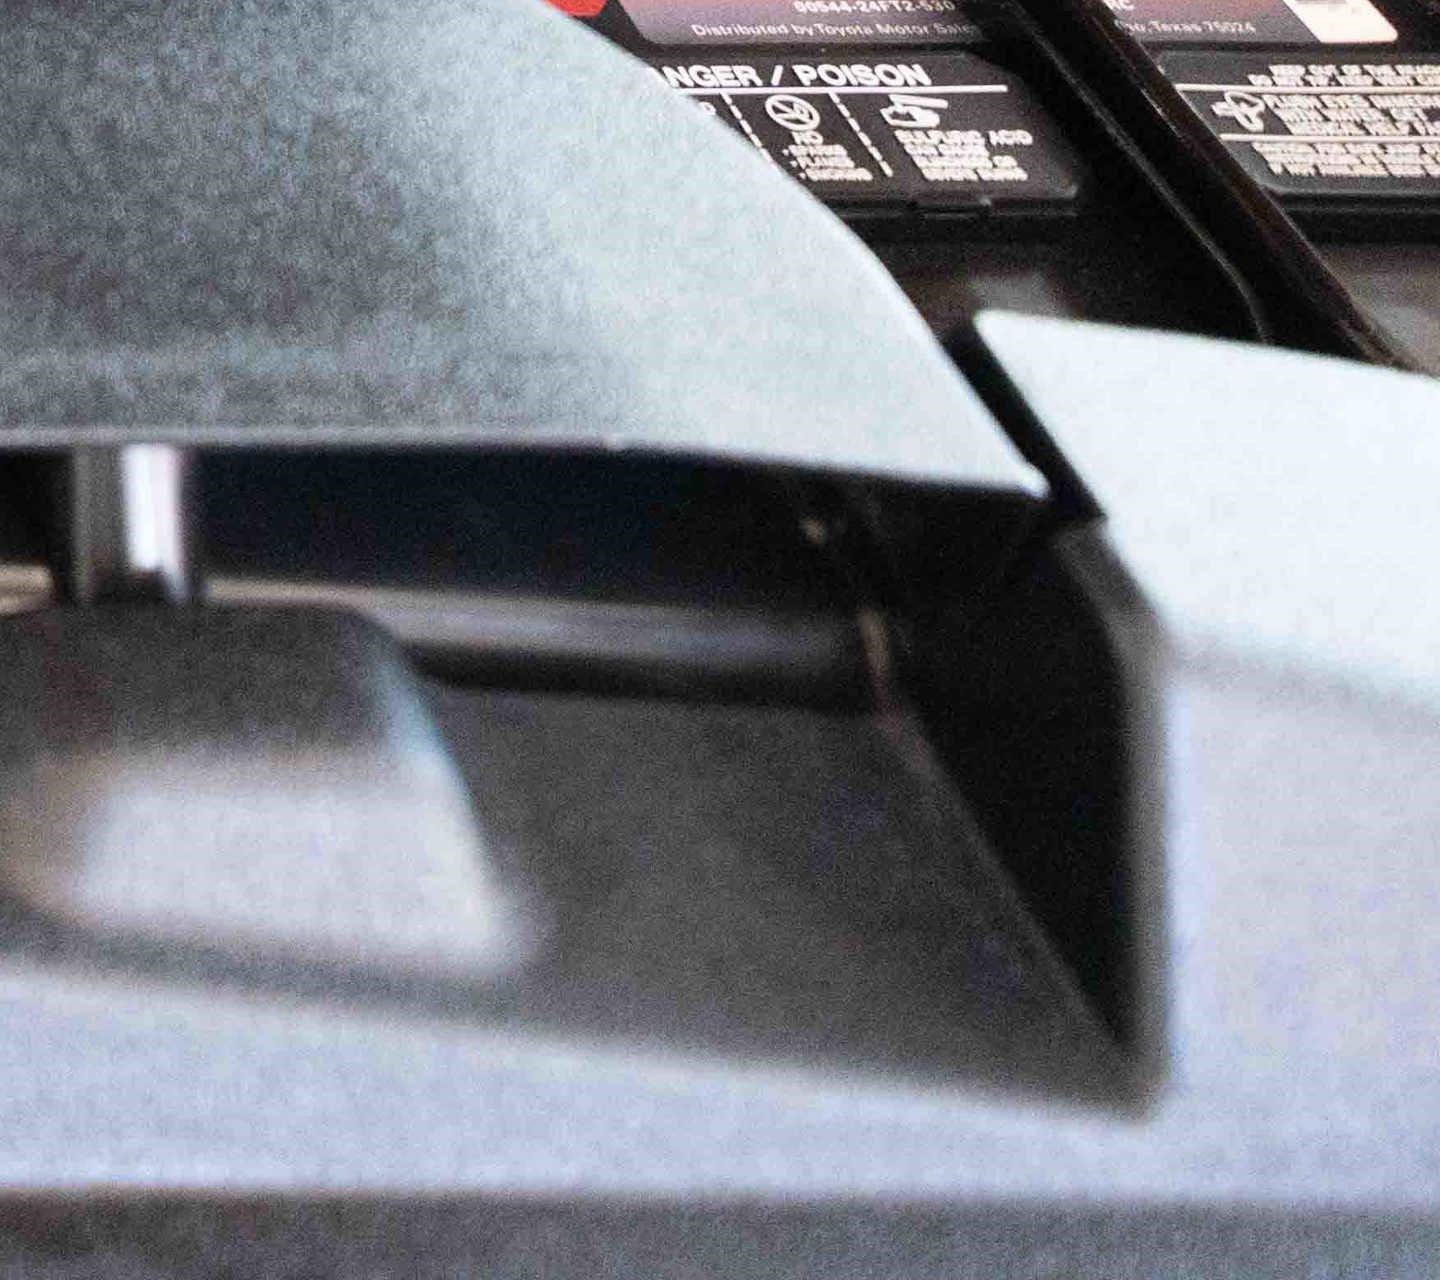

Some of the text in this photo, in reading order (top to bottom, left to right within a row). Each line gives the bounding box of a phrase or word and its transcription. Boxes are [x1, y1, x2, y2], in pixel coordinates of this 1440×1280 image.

[689, 22, 790, 38] Distributed
[790, 23, 814, 38] by
[814, 23, 874, 39] Toyota
[875, 22, 930, 37] Motor
[654, 62, 932, 88] NGER / POISON
